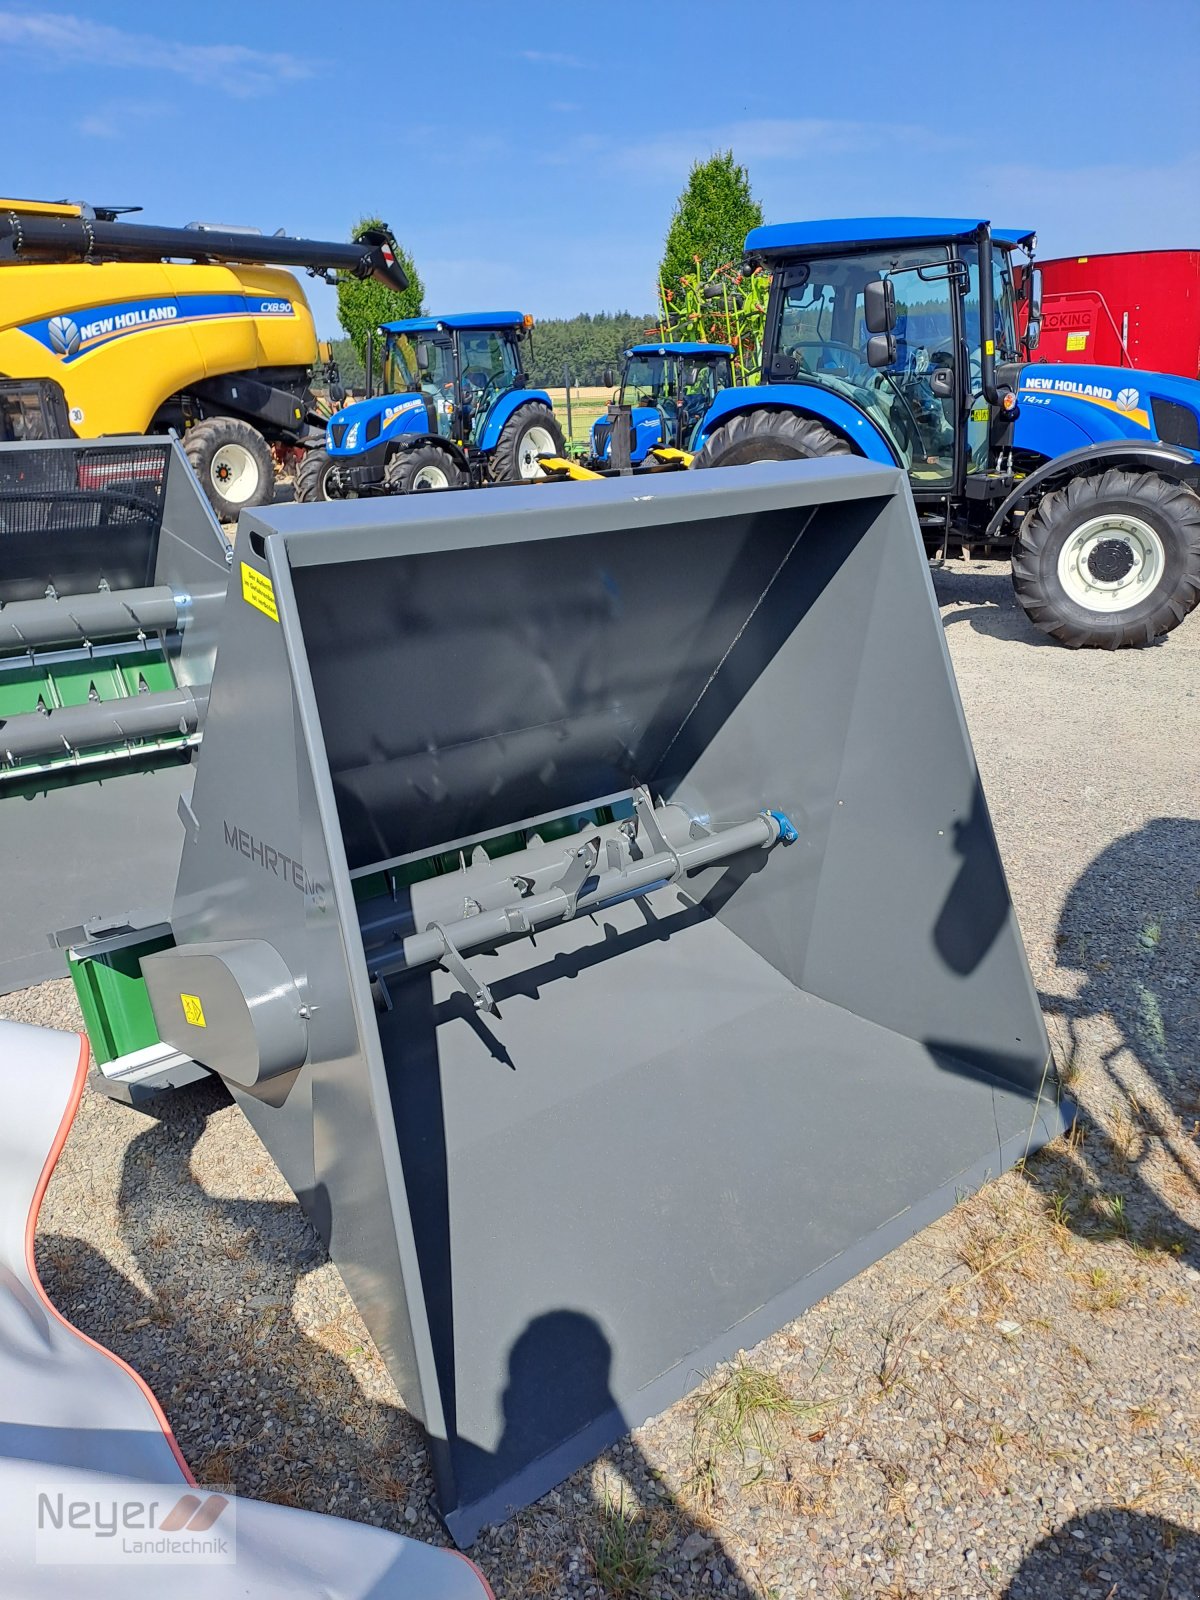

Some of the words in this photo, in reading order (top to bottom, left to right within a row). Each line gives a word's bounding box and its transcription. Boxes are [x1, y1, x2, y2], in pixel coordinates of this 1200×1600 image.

[260, 302, 292, 313] CX8.90
[81, 318, 114, 340] NEW
[115, 306, 178, 329] HOLLAND
[1043, 313, 1092, 328] LOKING
[1025, 377, 1053, 389] NEW
[1054, 379, 1113, 400] HOLLAND
[72, 410, 83, 421] 30
